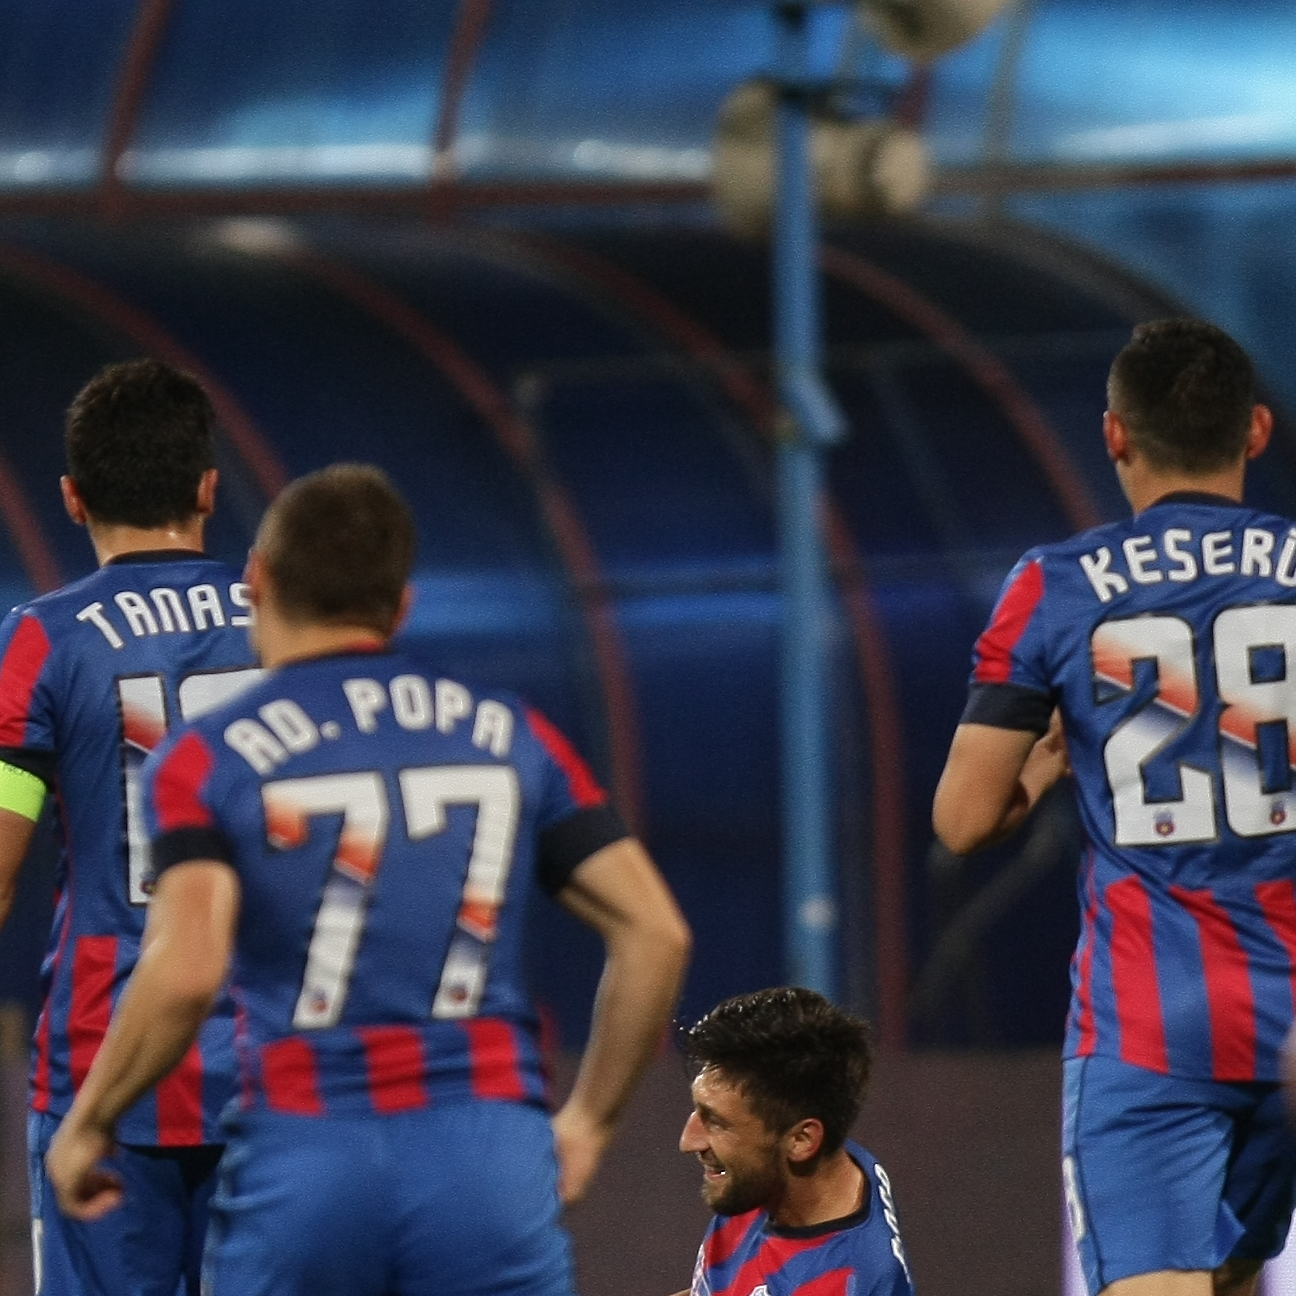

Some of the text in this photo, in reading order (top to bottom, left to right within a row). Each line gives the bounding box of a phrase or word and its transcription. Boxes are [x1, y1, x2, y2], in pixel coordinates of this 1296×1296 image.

[222, 674, 516, 777] AD. POPA
[262, 763, 521, 1030] 77
